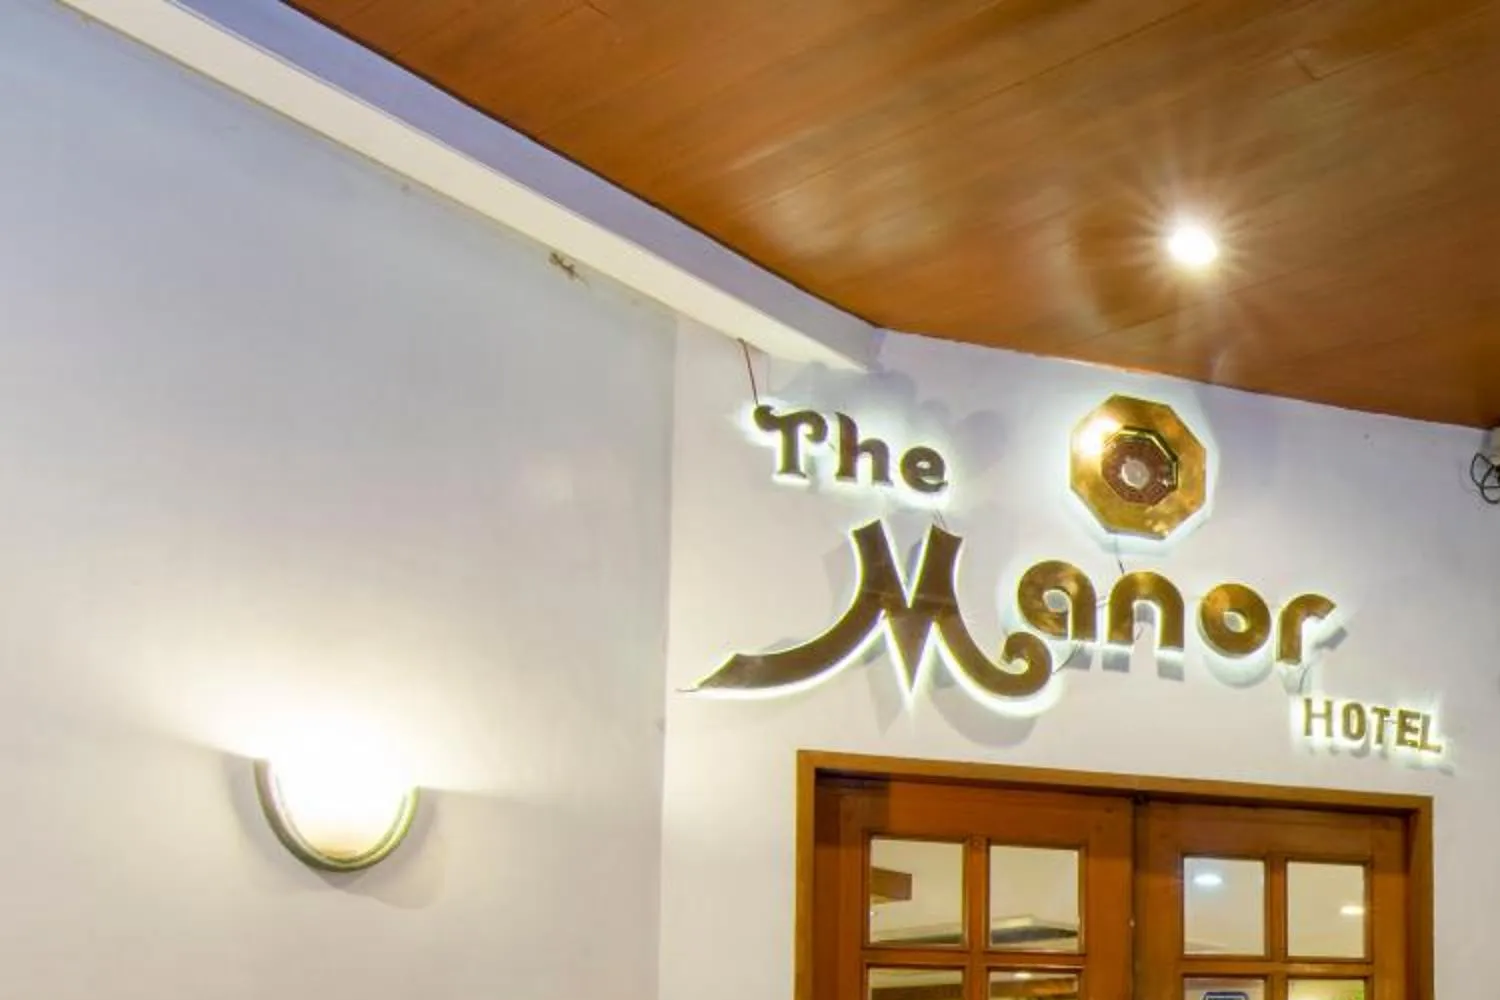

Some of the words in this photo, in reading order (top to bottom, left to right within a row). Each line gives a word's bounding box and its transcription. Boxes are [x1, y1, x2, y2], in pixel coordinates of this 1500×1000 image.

[754, 405, 948, 492] The
[677, 519, 1335, 697] Manor
[1304, 698, 1442, 753] HOTEL
